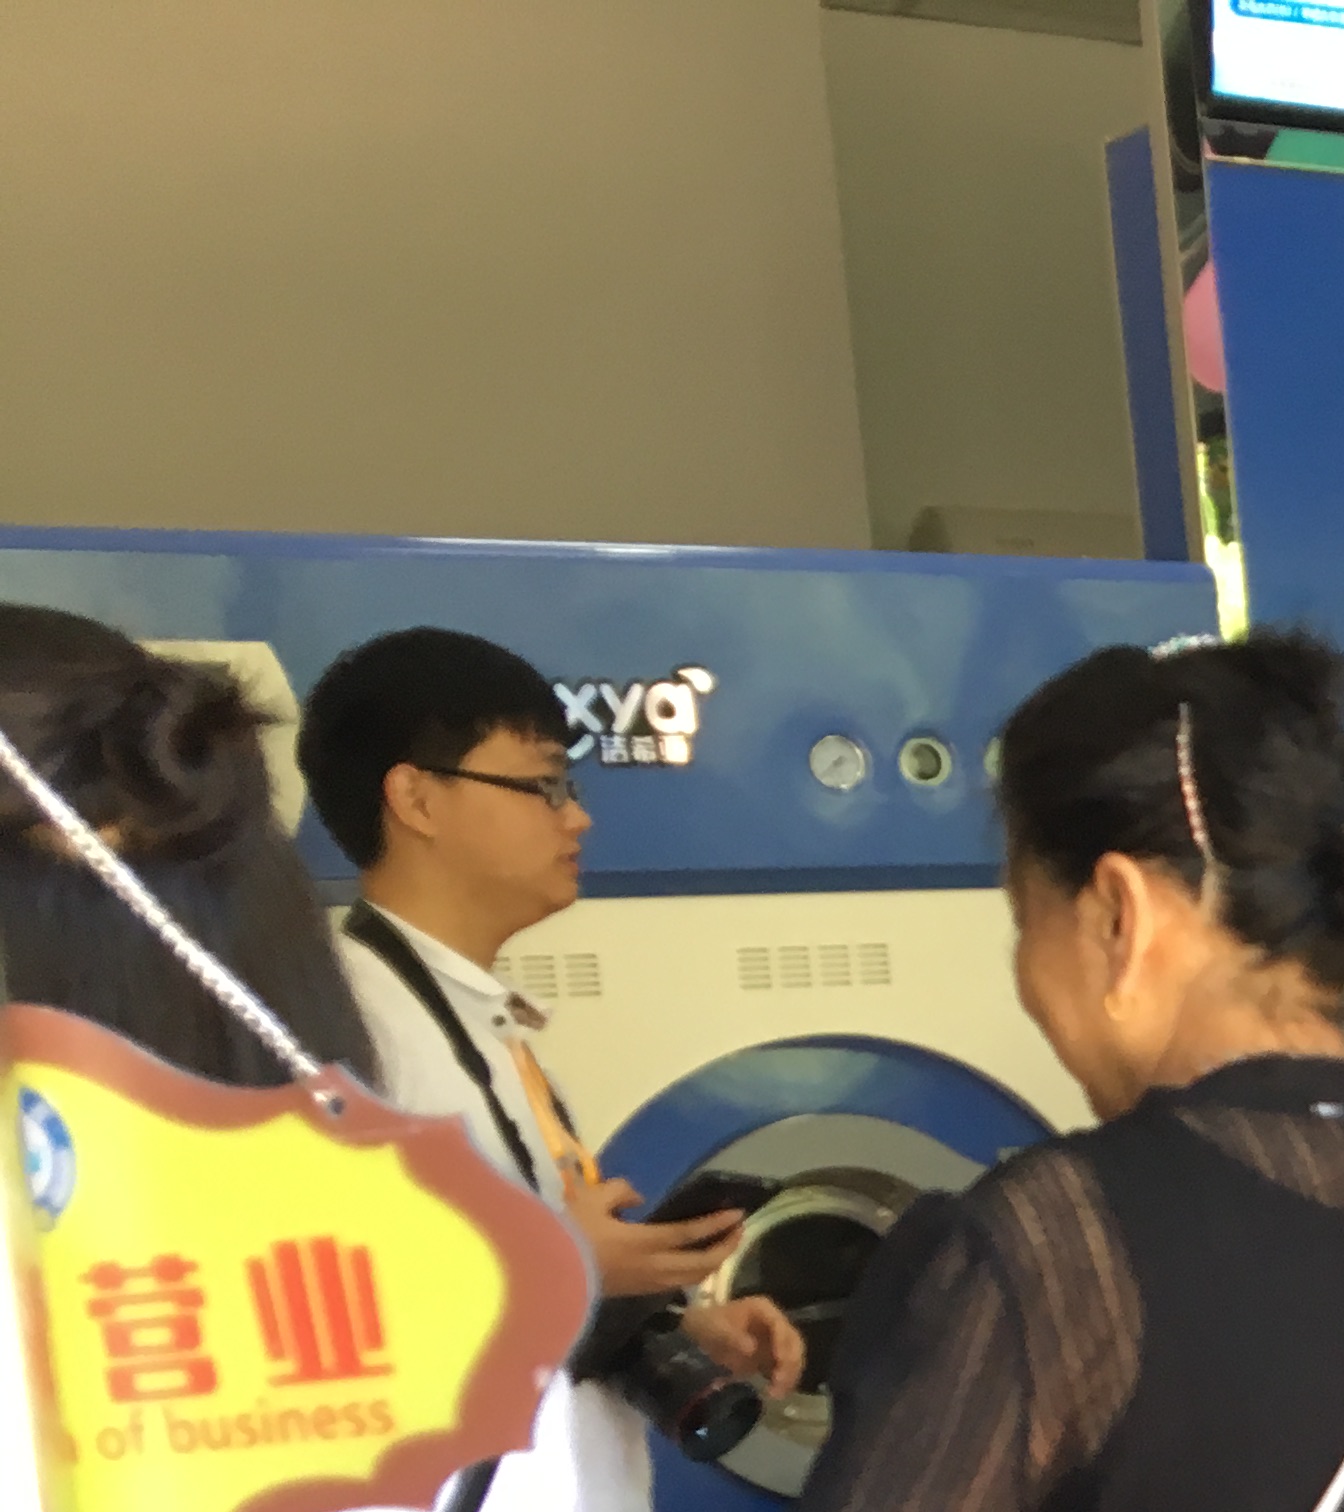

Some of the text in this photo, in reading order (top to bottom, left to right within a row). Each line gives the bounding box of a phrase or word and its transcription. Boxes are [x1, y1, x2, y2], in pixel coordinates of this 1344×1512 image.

[552, 682, 698, 734] xya
[78, 1234, 396, 1404] 营业
[95, 1406, 146, 1461] of
[164, 1398, 396, 1454] business
